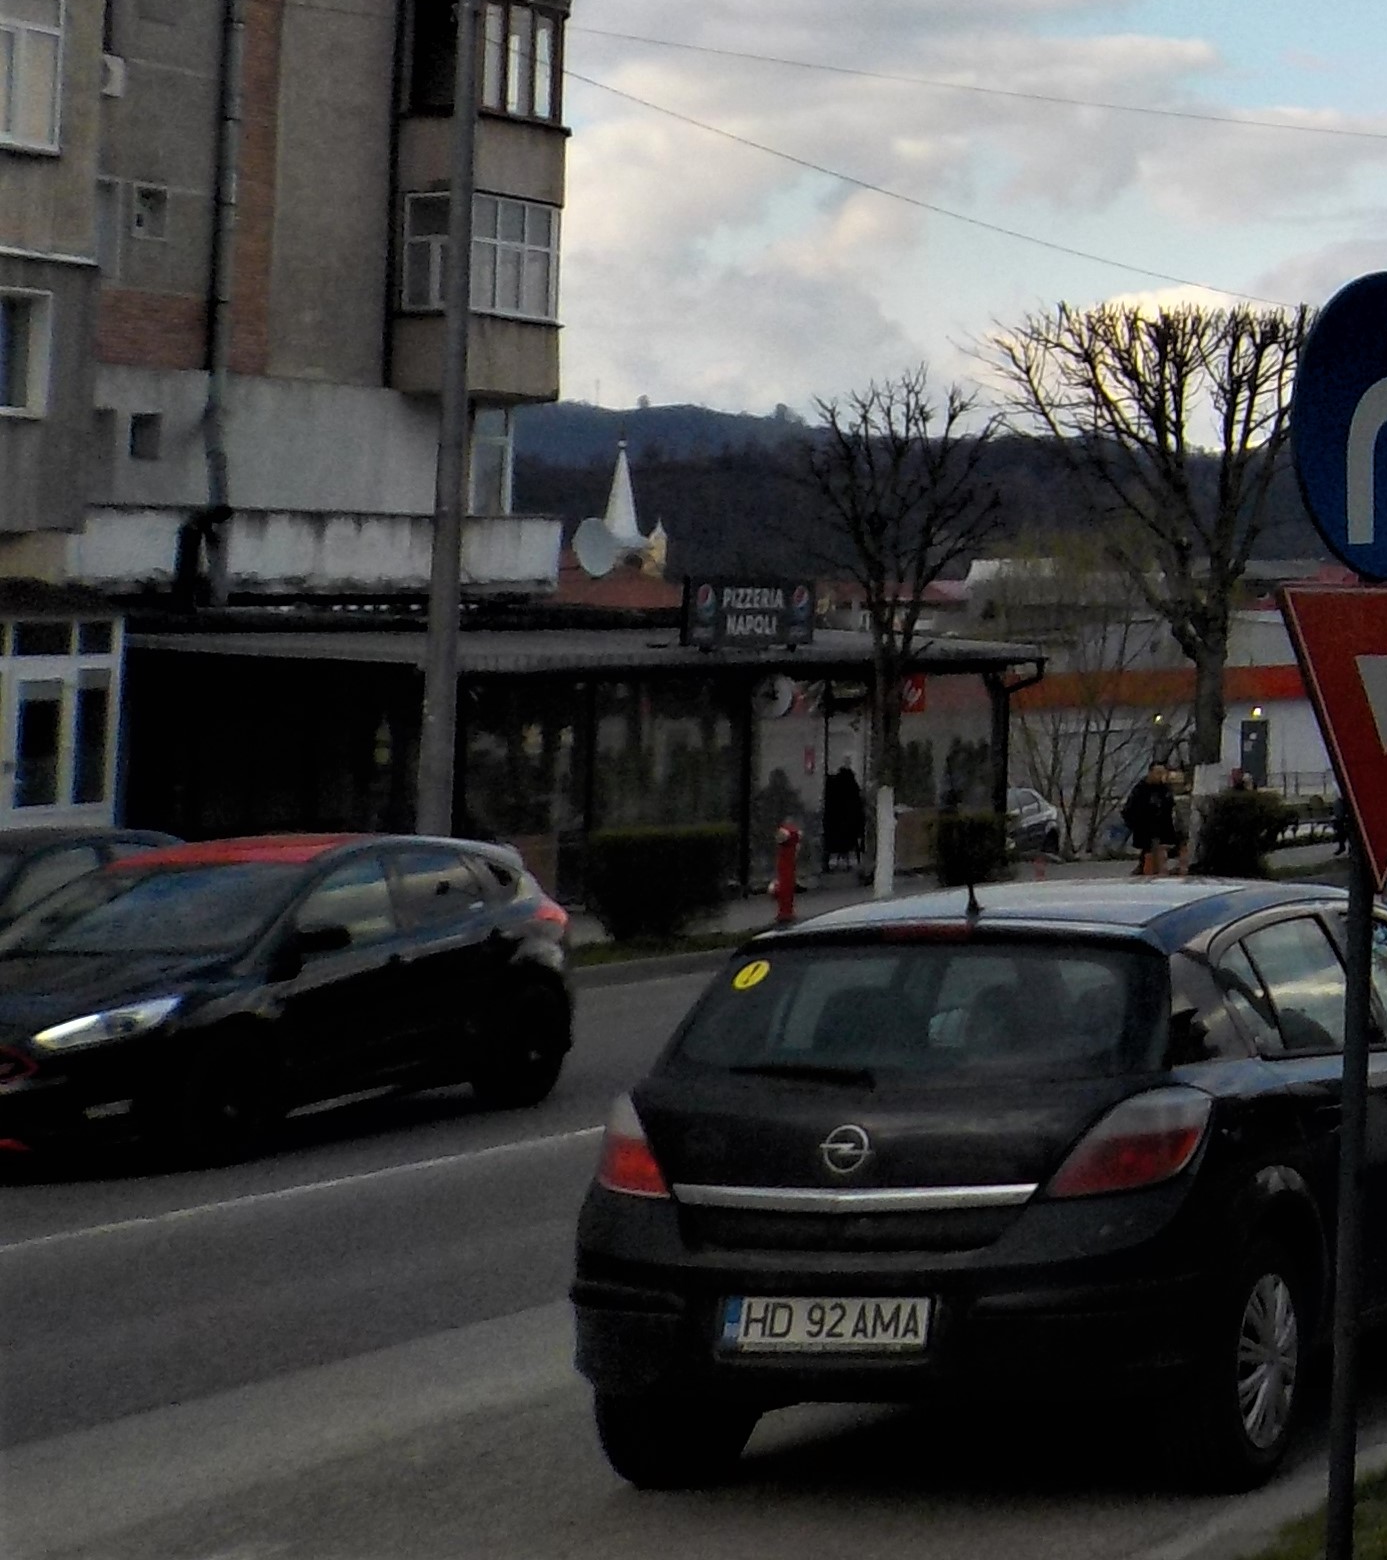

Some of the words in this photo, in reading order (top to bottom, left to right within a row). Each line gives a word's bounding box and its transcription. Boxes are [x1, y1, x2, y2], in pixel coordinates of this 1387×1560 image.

[723, 588, 784, 608] PIZZERIA
[726, 614, 777, 635] NAPOLI
[743, 1302, 794, 1338] HD
[806, 1302, 847, 1338] 92
[851, 1302, 920, 1338] AMA
